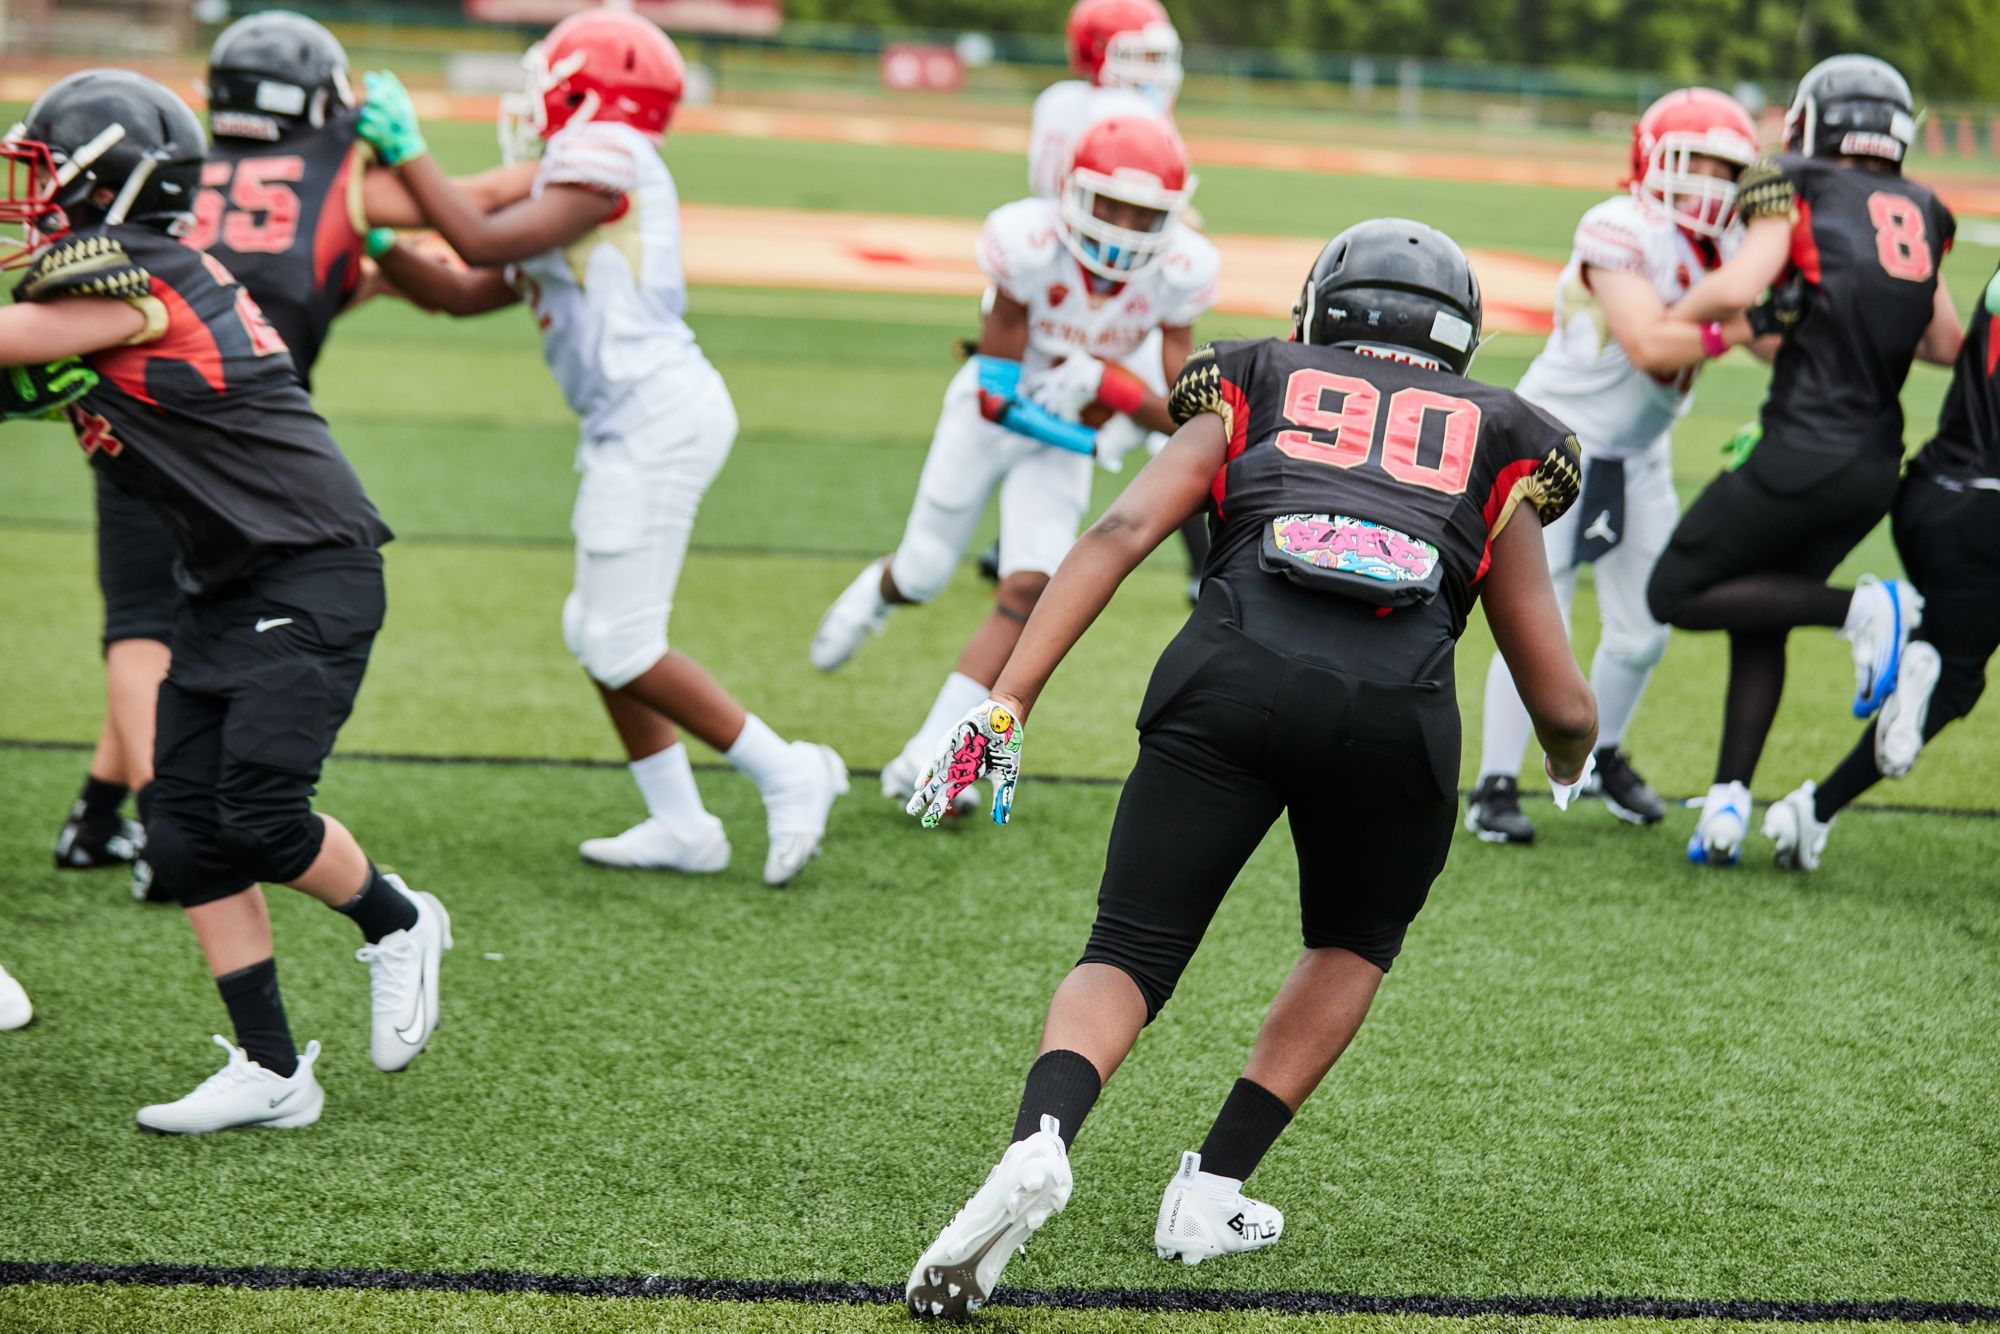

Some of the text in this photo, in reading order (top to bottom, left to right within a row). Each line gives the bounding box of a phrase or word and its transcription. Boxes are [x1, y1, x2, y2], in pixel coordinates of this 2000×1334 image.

[1868, 190, 1934, 283] 8
[1275, 367, 1482, 496] 90
[1226, 1211, 1277, 1241] BTTLE
